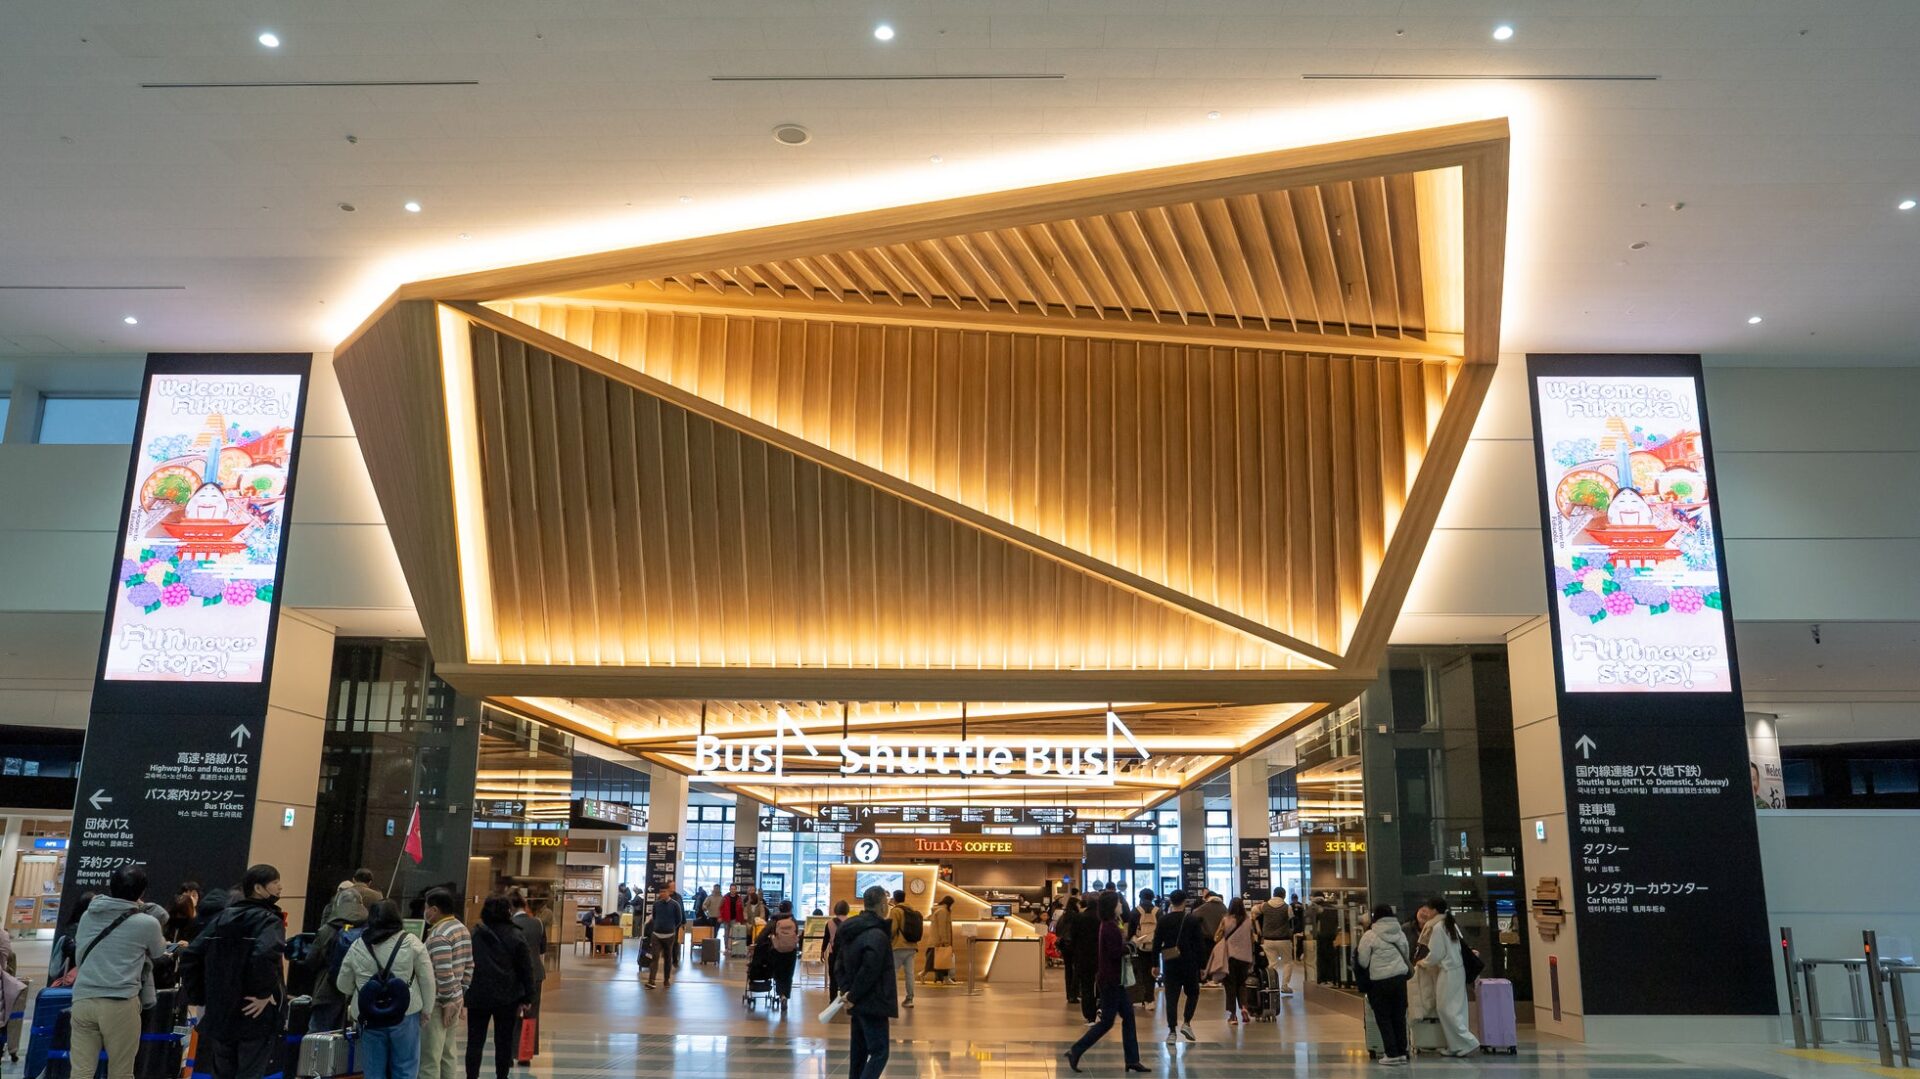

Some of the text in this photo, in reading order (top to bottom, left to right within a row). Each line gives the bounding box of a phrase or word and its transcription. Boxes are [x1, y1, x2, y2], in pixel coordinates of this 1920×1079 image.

[158, 379, 275, 398] Welcome to
[1546, 381, 1671, 400] Welcome to
[187, 637, 257, 652] never
[1644, 645, 1717, 661] never
[138, 650, 229, 679] stops!
[1598, 661, 1694, 689] stops!
[177, 752, 248, 764] 高速・路線バス
[695, 735, 773, 773] Bus
[840, 736, 1103, 774] Shuttle Bus
[150, 765, 181, 774] Highway
[1576, 778, 1605, 786] Shuttle
[1655, 778, 1694, 787] Domestic,
[1695, 778, 1729, 787] Subway)
[144, 788, 245, 801] バス案内カウンター
[1578, 803, 1616, 816] 駐車場
[84, 817, 130, 830] 団体バス
[1580, 818, 1610, 826] Parking
[83, 831, 119, 839] Chartered
[964, 842, 1012, 852] COFFEE
[1583, 843, 1630, 855] タクシー
[79, 856, 147, 869] 予約タクシー
[1583, 857, 1600, 865] Taxi
[76, 869, 111, 877] Reserved
[1587, 882, 1709, 895] レンタカーカウンター
[1587, 896, 1628, 904] Car Rental
